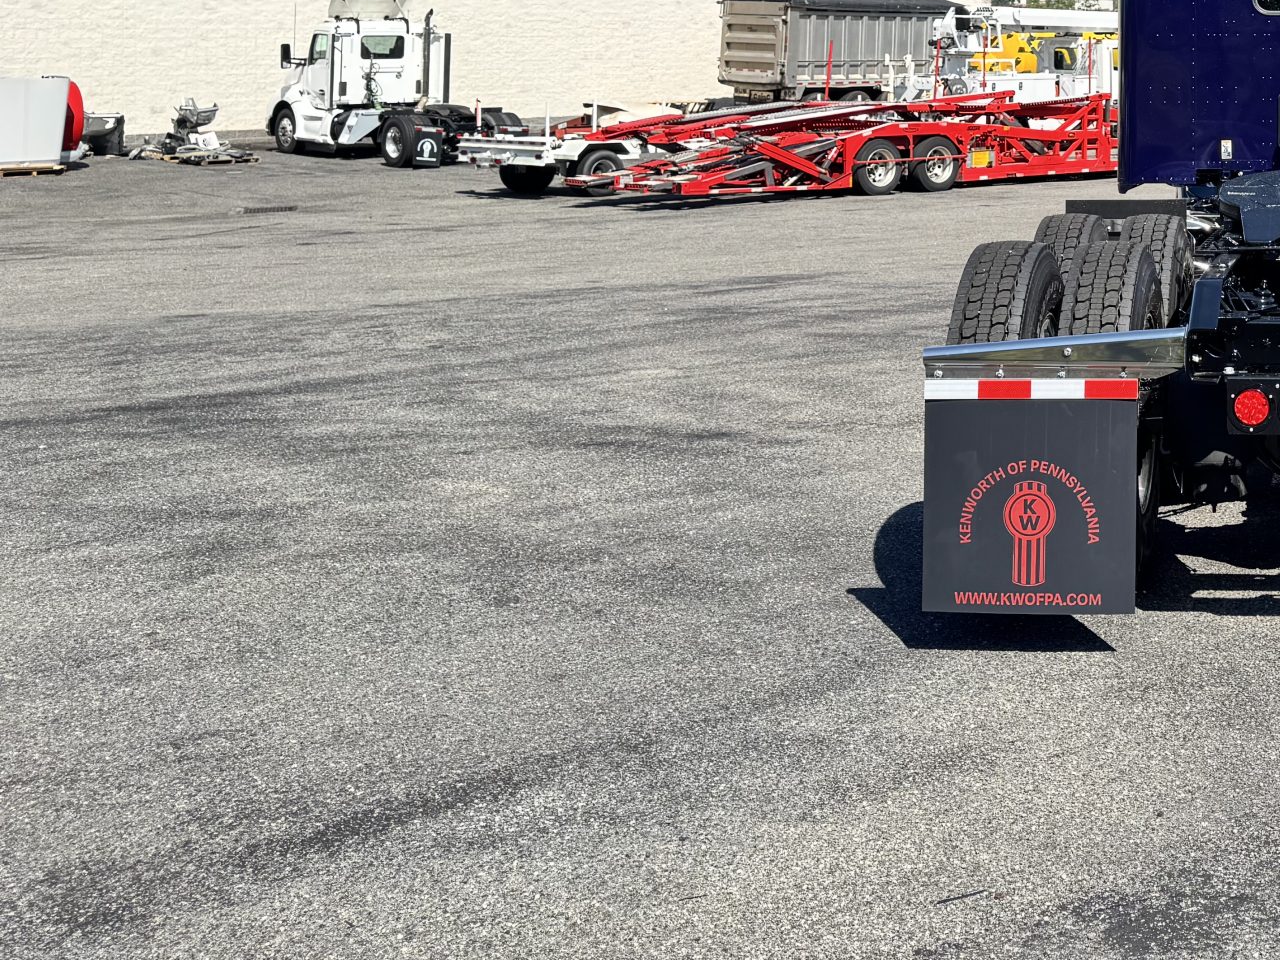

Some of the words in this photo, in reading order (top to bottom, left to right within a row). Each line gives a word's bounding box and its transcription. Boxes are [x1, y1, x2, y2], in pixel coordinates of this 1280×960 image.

[959, 467, 1006, 544] KENWORTH
[1007, 460, 1027, 475] OF
[1030, 459, 1100, 544] PENNSYLVANIA
[1023, 498, 1037, 515] K
[1018, 515, 1041, 531] W
[954, 591, 1102, 606] WWW.KWOFPA.COM
